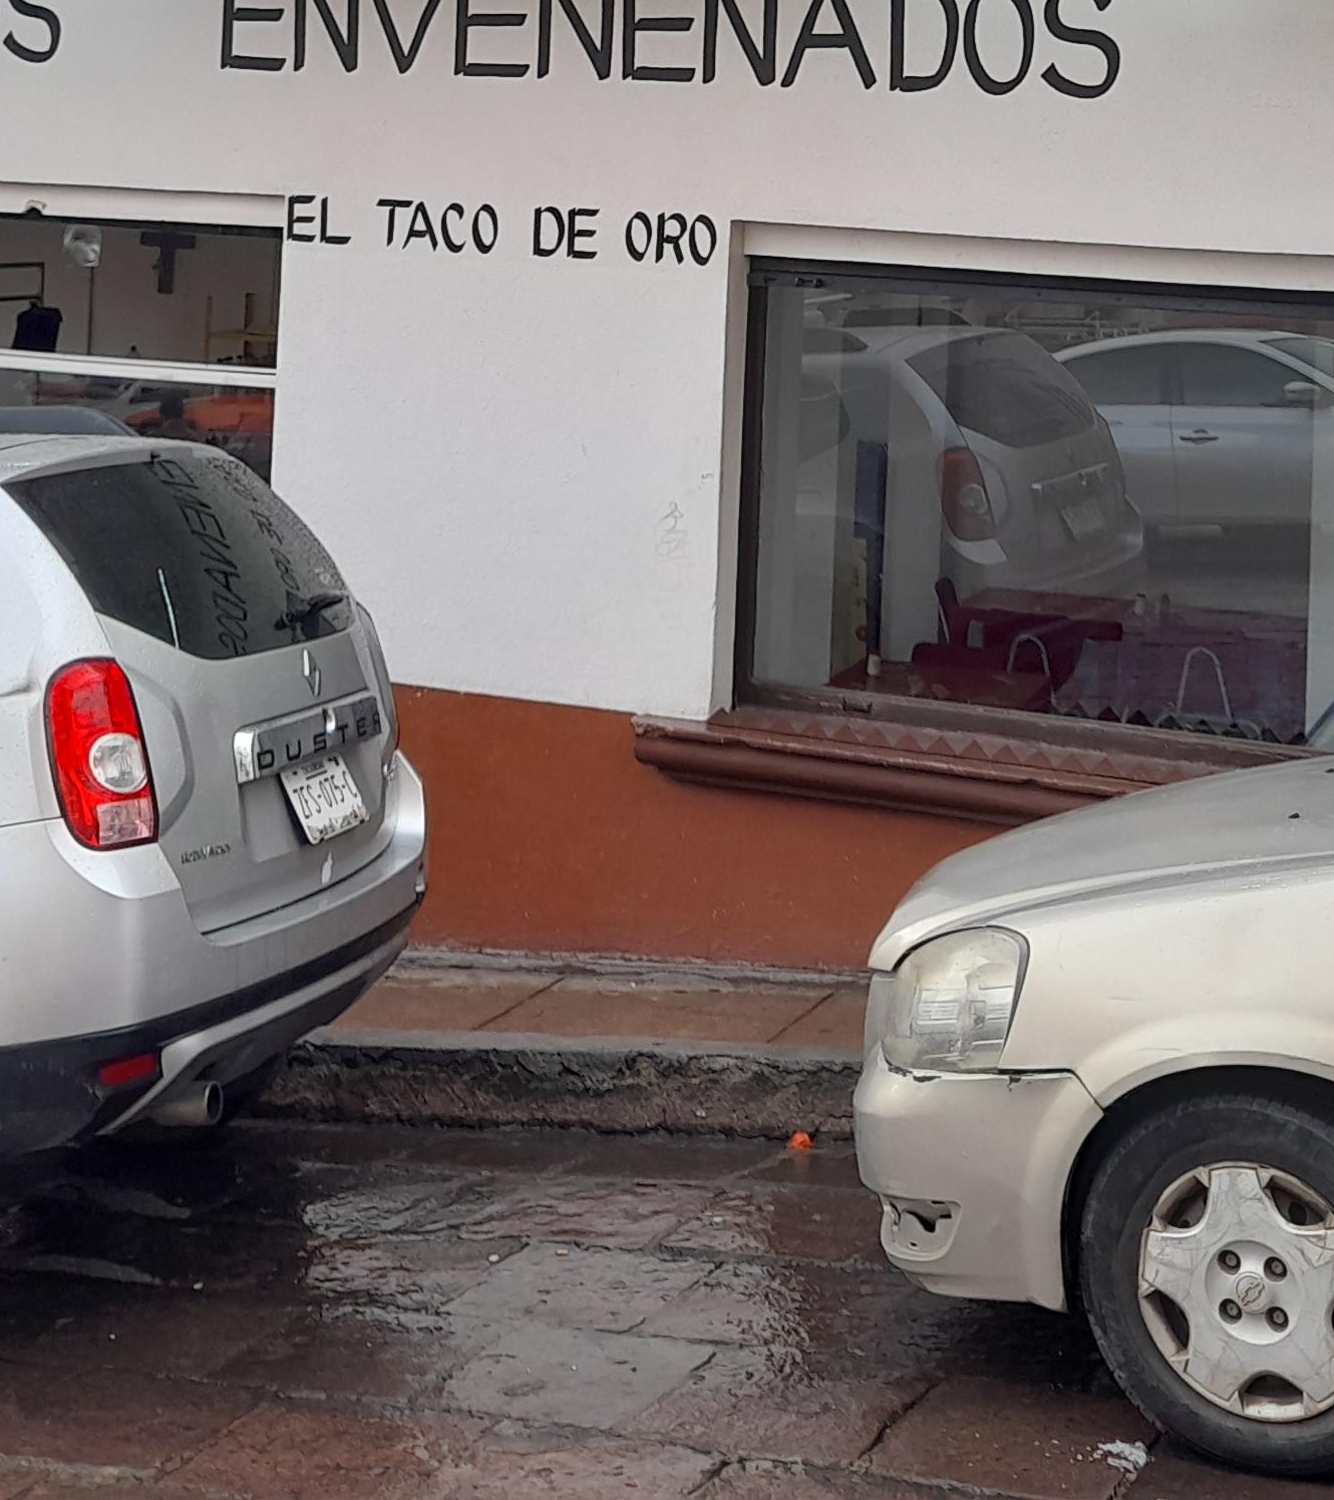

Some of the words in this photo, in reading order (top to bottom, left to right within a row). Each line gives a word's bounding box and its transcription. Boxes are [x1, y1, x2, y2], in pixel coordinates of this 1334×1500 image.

[286, 195, 352, 245] EL
[376, 198, 499, 255] TACO
[532, 206, 600, 259] DE
[625, 211, 717, 267] ORO
[256, 713, 382, 771] DUSTER
